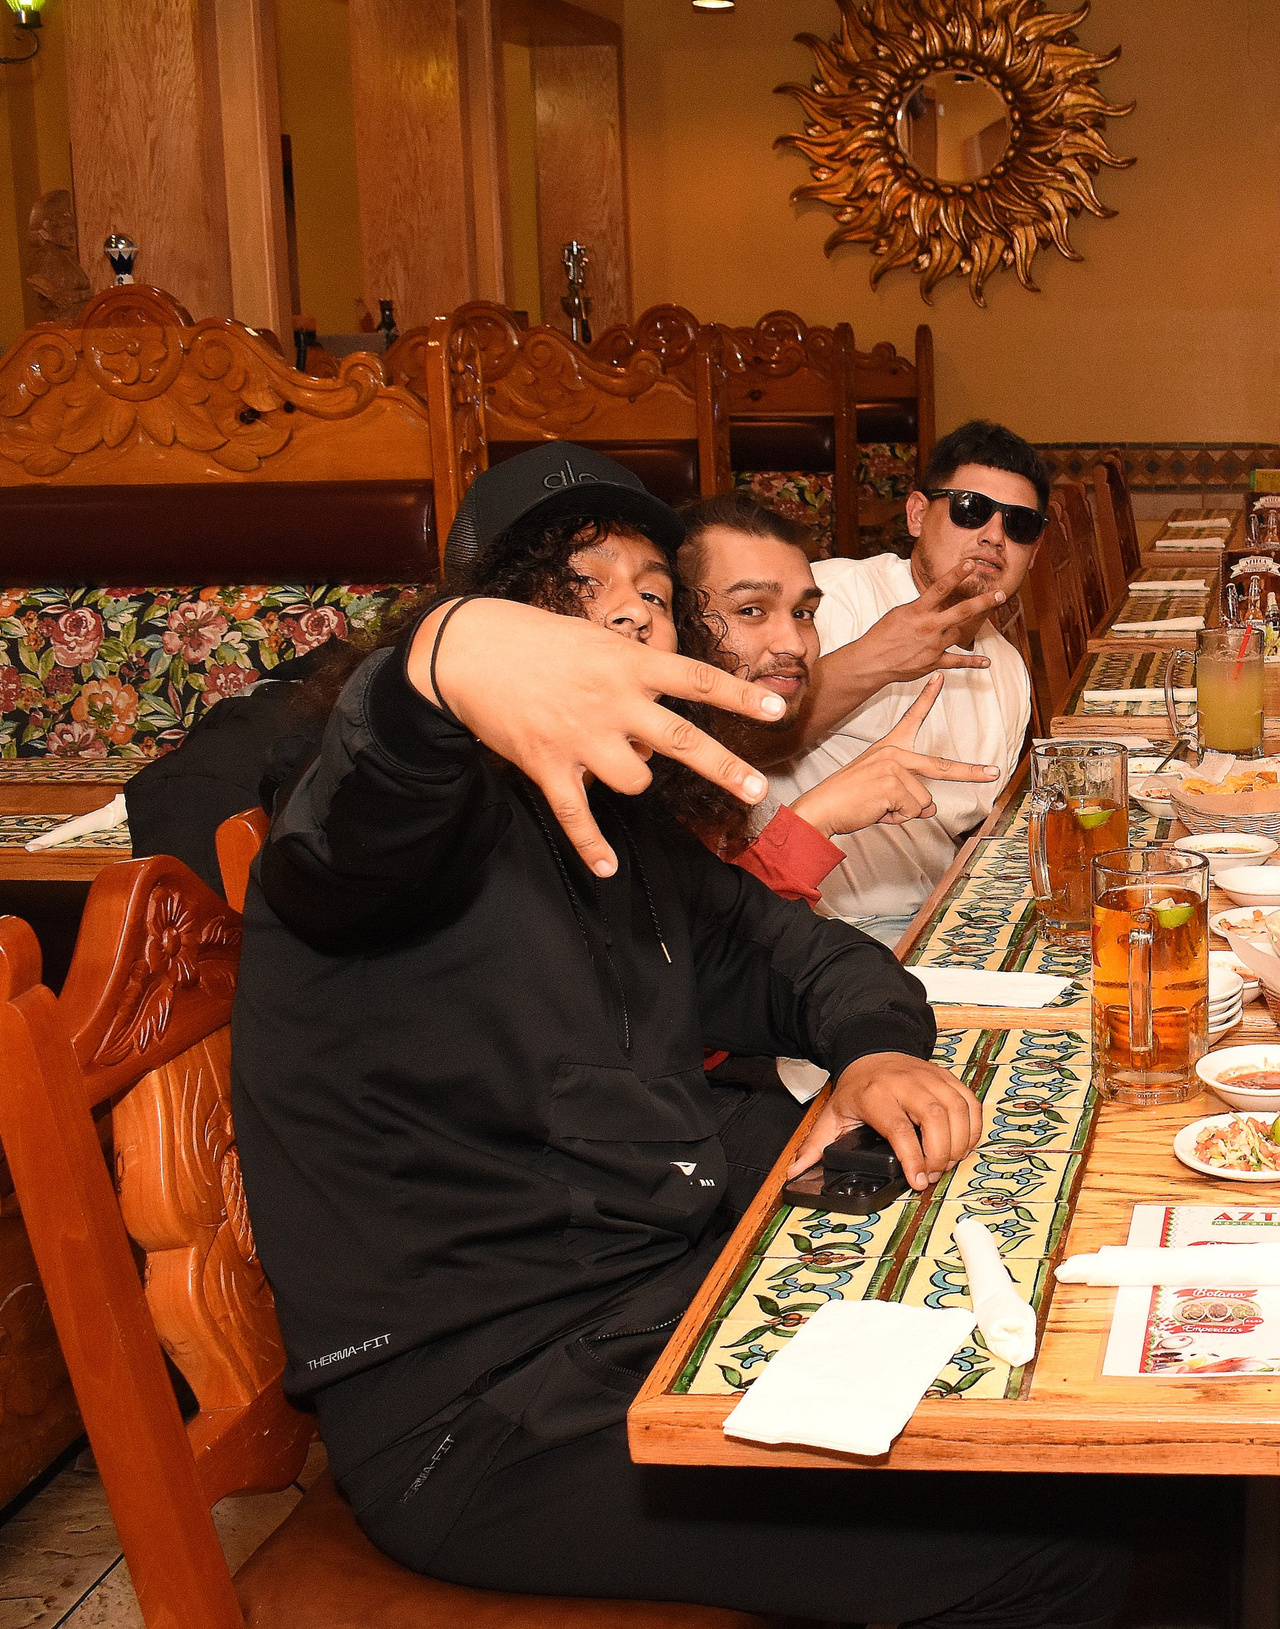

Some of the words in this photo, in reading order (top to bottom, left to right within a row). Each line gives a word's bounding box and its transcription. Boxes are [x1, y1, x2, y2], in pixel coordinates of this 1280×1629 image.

[1192, 1288, 1247, 1298] Botana
[1181, 1324, 1243, 1334] Emperador
[307, 1333, 391, 1370] THERMA-FIT
